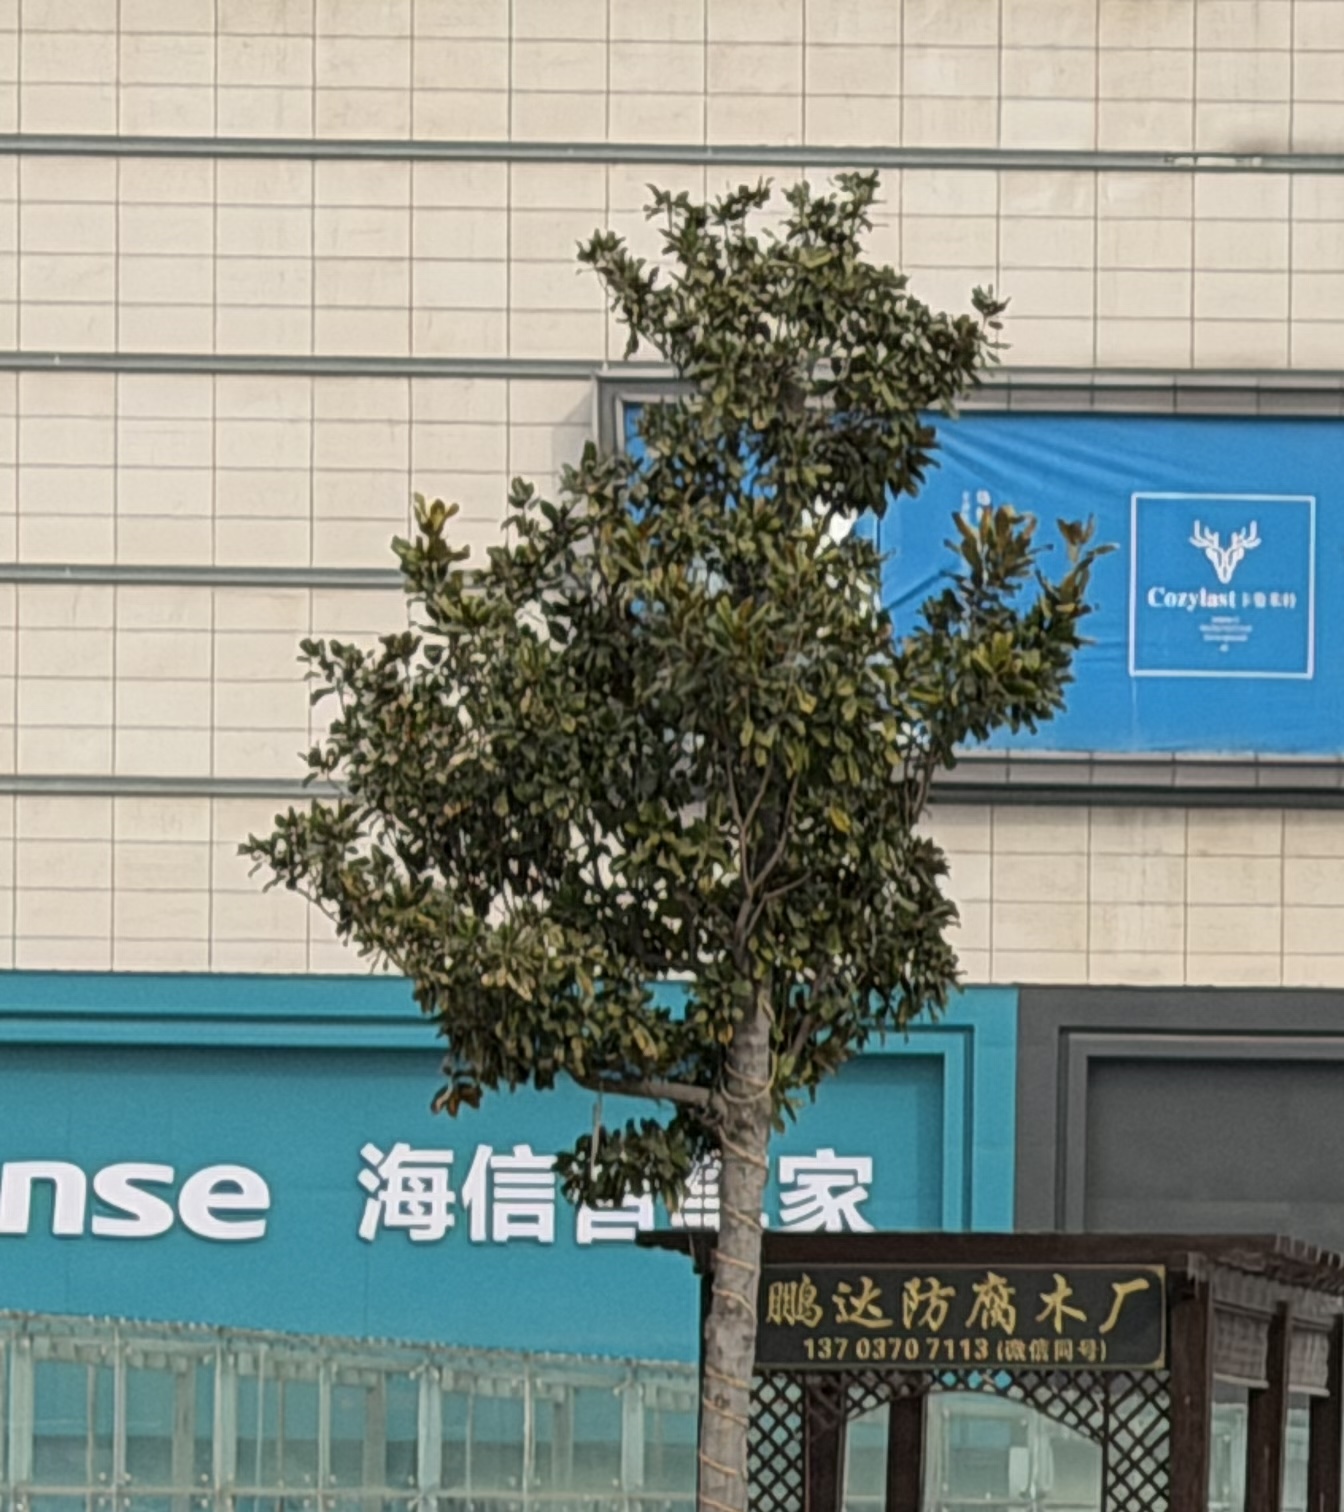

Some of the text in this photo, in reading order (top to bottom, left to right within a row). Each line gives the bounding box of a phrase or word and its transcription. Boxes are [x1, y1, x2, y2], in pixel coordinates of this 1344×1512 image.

[766, 1271, 1150, 1336] 鹏达防腐木厂
[804, 1338, 848, 1361] 137
[856, 1337, 920, 1362] 0370
[927, 1338, 990, 1361] 7113
